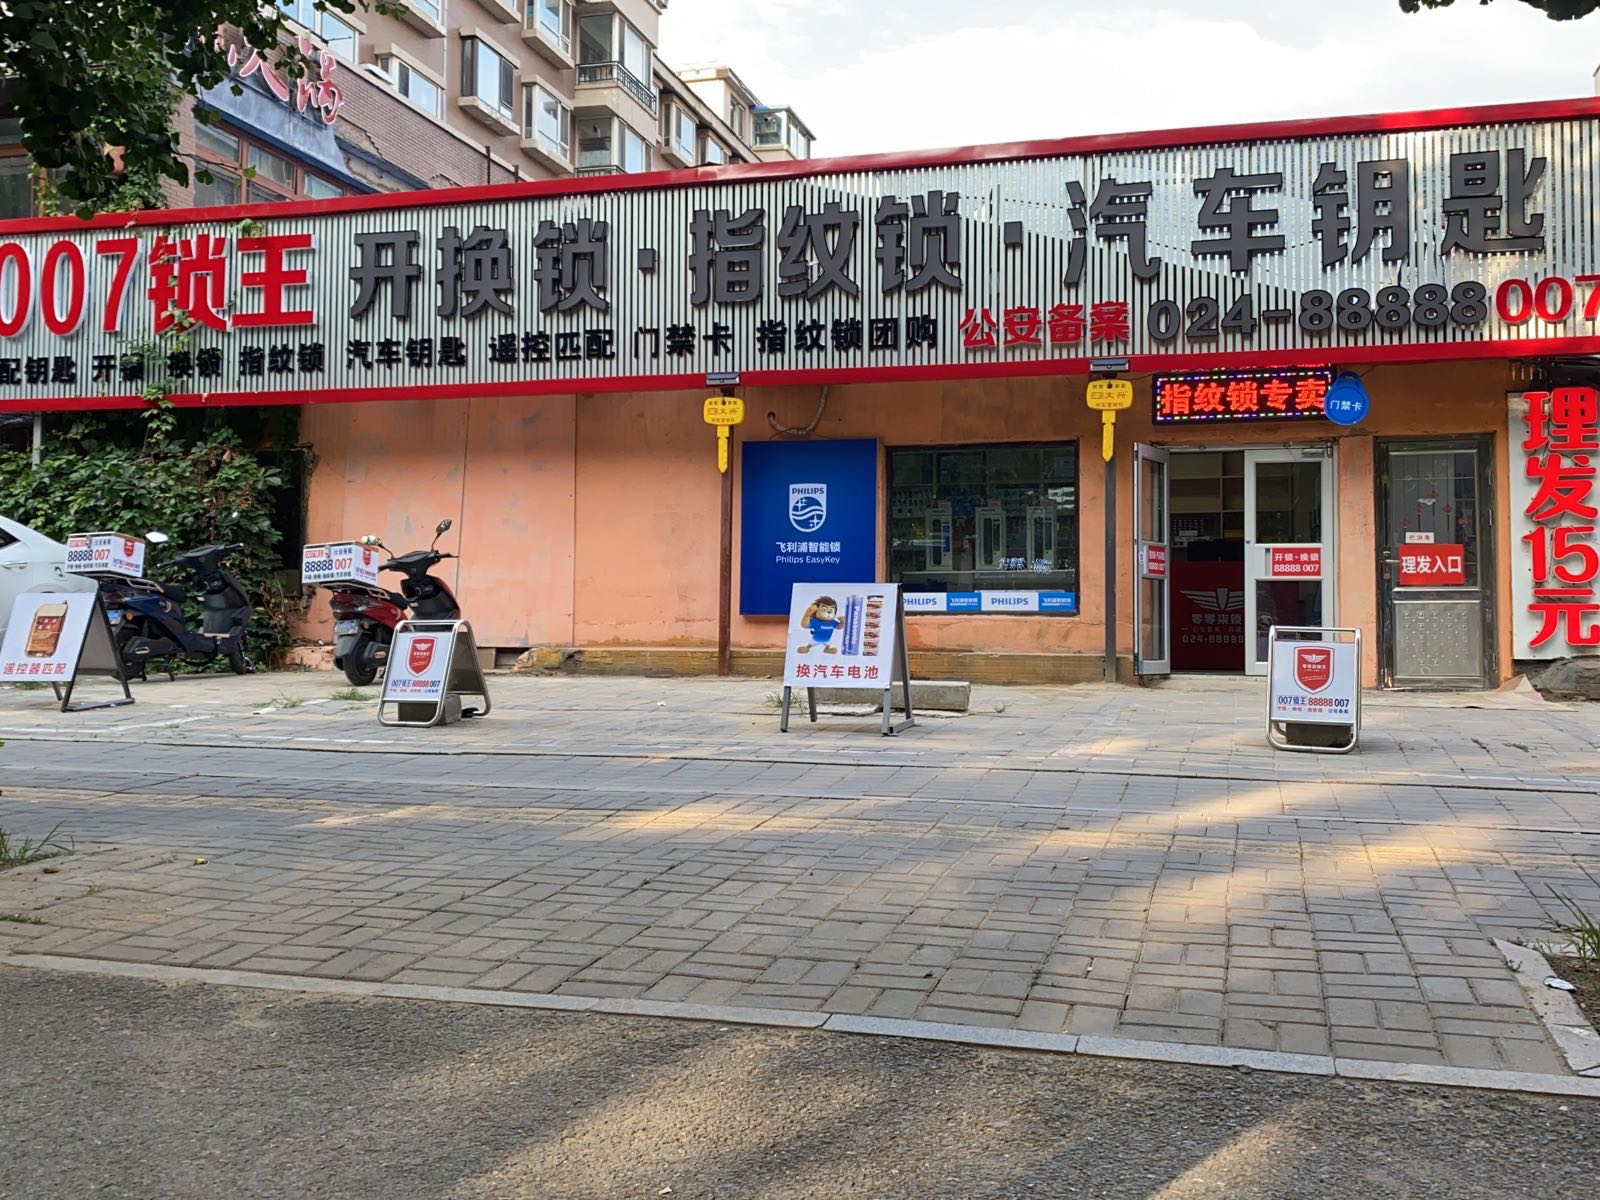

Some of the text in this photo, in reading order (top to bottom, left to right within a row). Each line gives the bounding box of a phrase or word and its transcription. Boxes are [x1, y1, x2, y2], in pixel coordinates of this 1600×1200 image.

[0, 233, 316, 336] 007锁王
[0, 356, 77, 385] 配钥匙
[239, 342, 325, 376] 指纹锁
[346, 337, 466, 371] 汽车钥匙
[489, 329, 615, 364] 遥控匹配
[633, 322, 732, 359] 门禁卡
[757, 314, 937, 355] 指纹锁团购
[960, 300, 1131, 348] 公安备案
[1147, 282, 1488, 341] 024-88888
[1161, 378, 1326, 415] 指纹锁专卖
[1330, 400, 1362, 411] 门禁卡
[792, 487, 825, 495] PHILIPS
[1521, 387, 1600, 648] 理发15元
[776, 541, 841, 553] 飞利浦智能锁
[67, 549, 110, 562] 88888 007
[776, 555, 841, 565] Philips EasyKey
[304, 558, 353, 573] 88888 007
[1273, 564, 1319, 572] 88888 007
[1401, 555, 1462, 574] 理发入口
[991, 597, 1029, 606] PHILIPS
[3, 663, 67, 674] 遥控器匹配
[796, 664, 879, 679] 换汽车电池
[1334, 699, 1349, 707] 007
